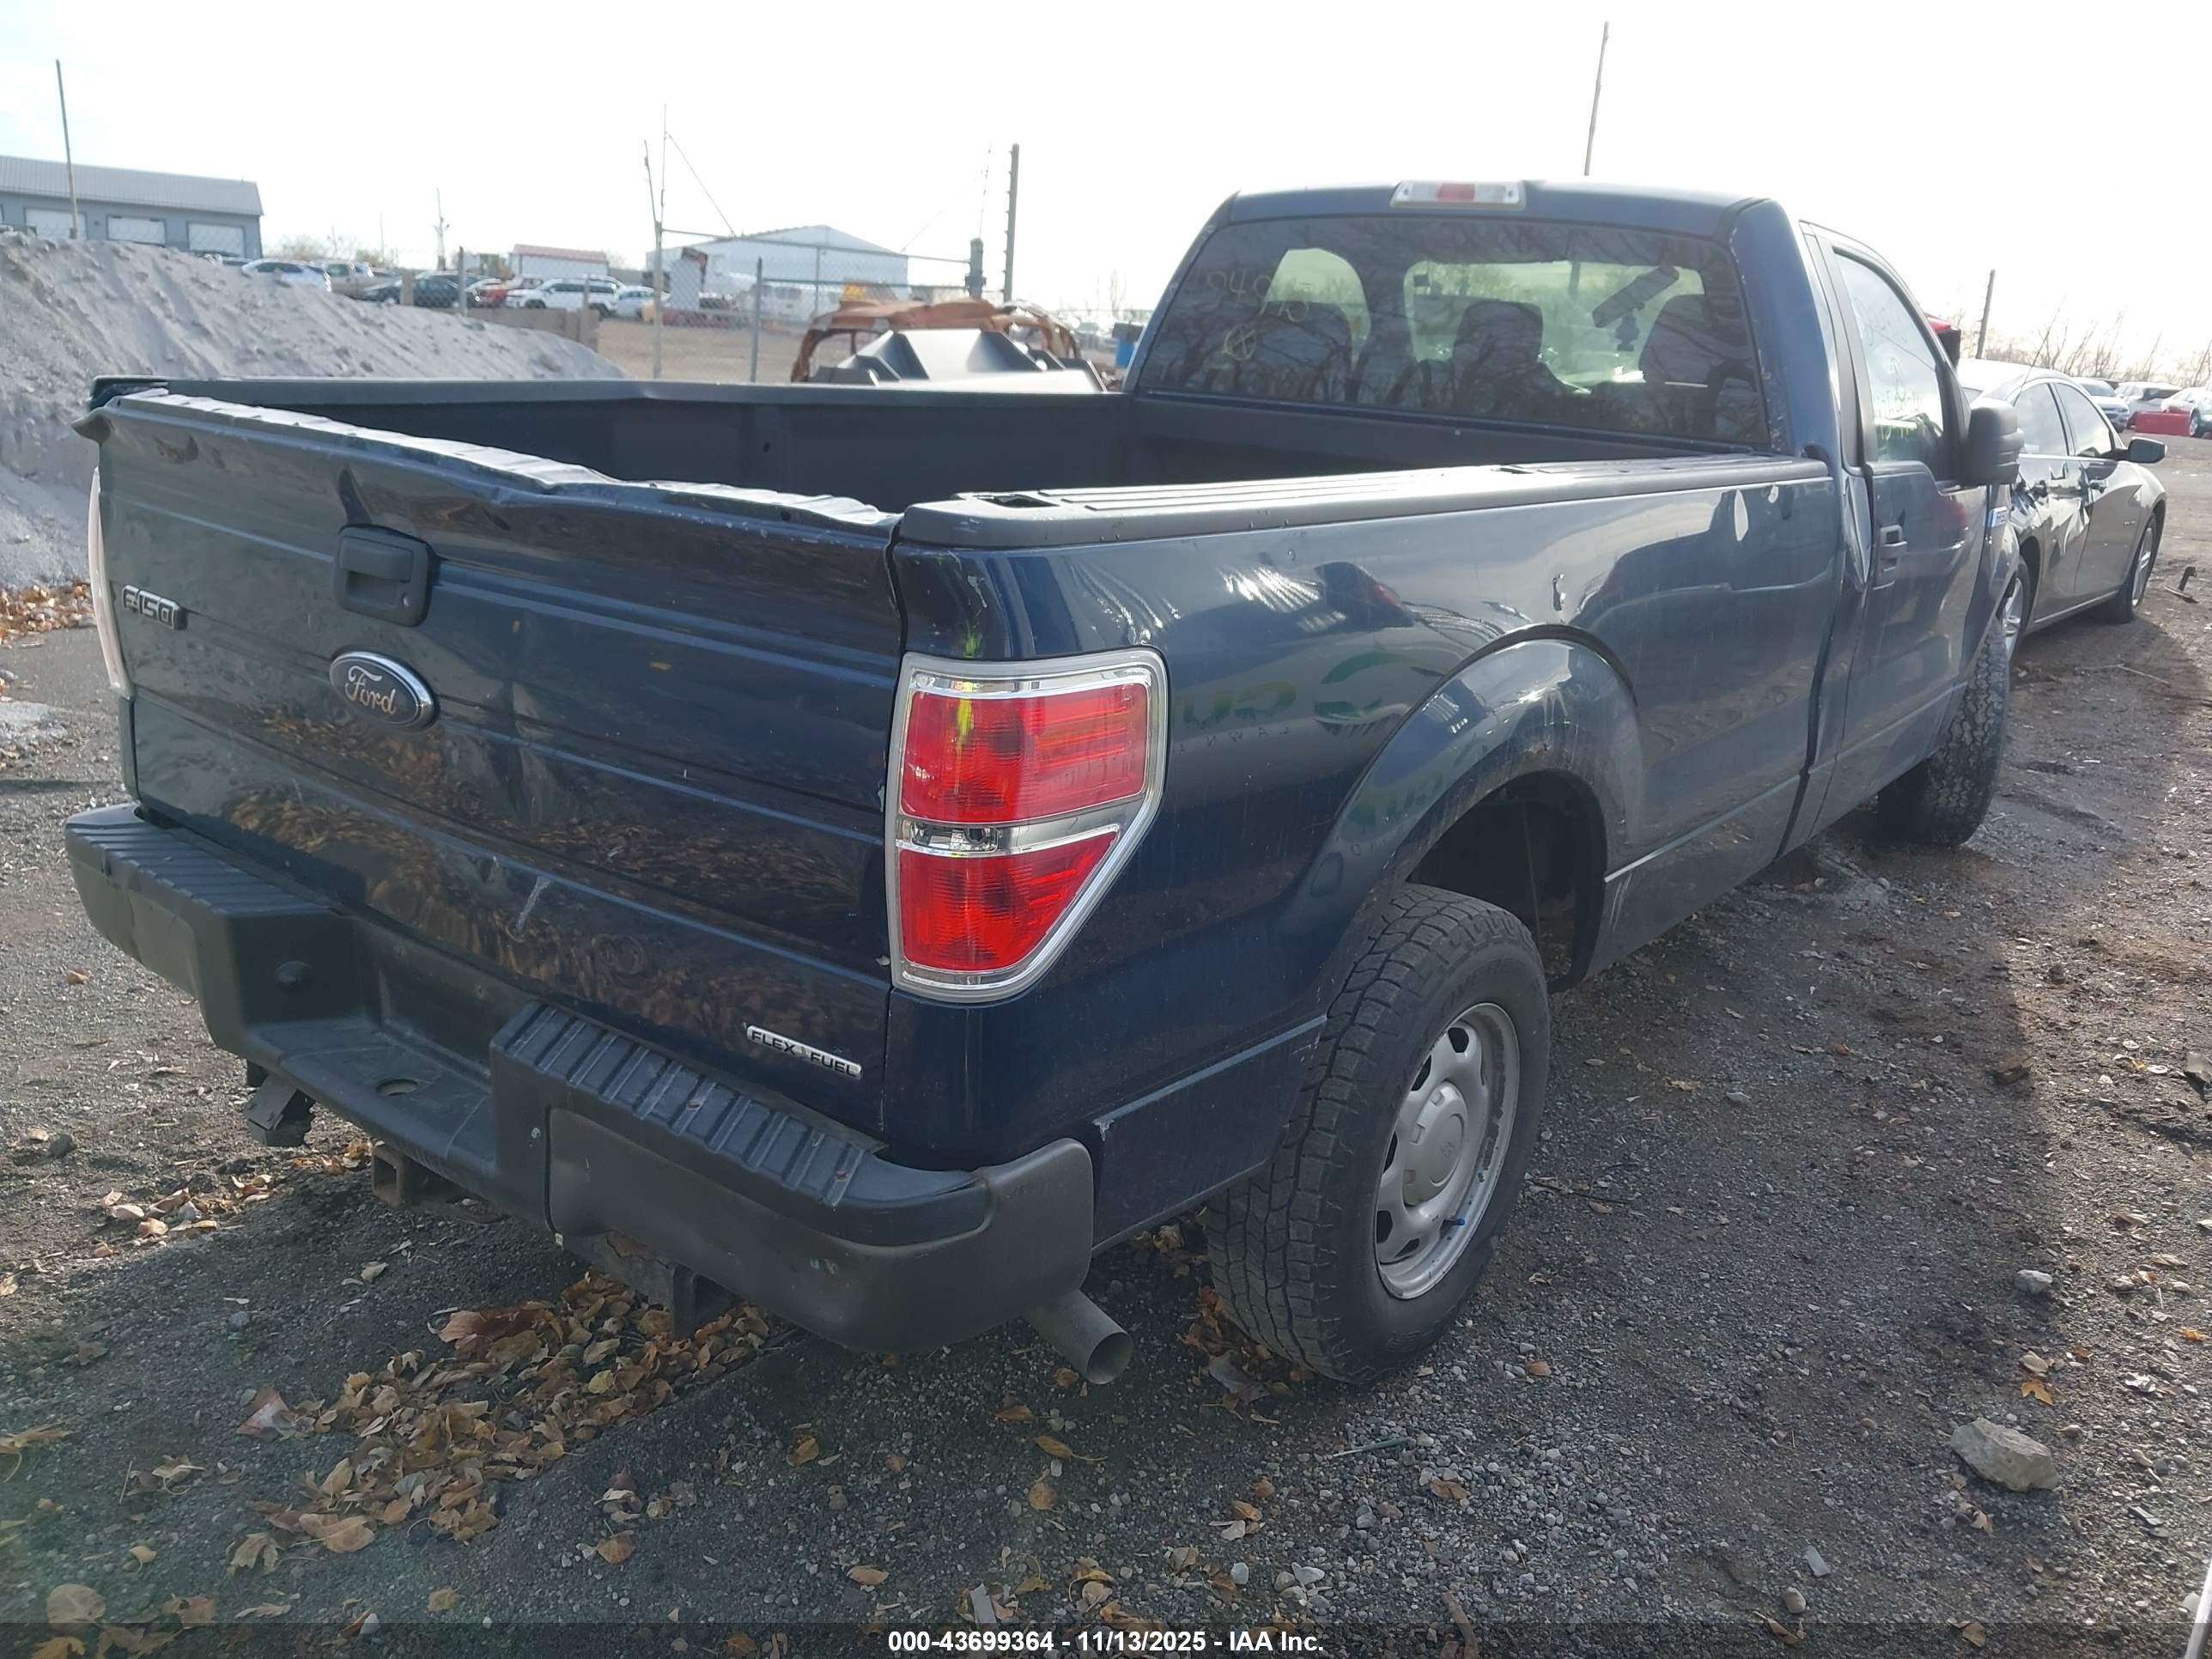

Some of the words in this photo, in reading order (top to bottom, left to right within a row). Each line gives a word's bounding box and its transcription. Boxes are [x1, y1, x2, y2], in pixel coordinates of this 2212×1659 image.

[344, 665, 397, 715] Ford
[750, 1029, 797, 1056] FLEX
[809, 1051, 858, 1079] FUEL
